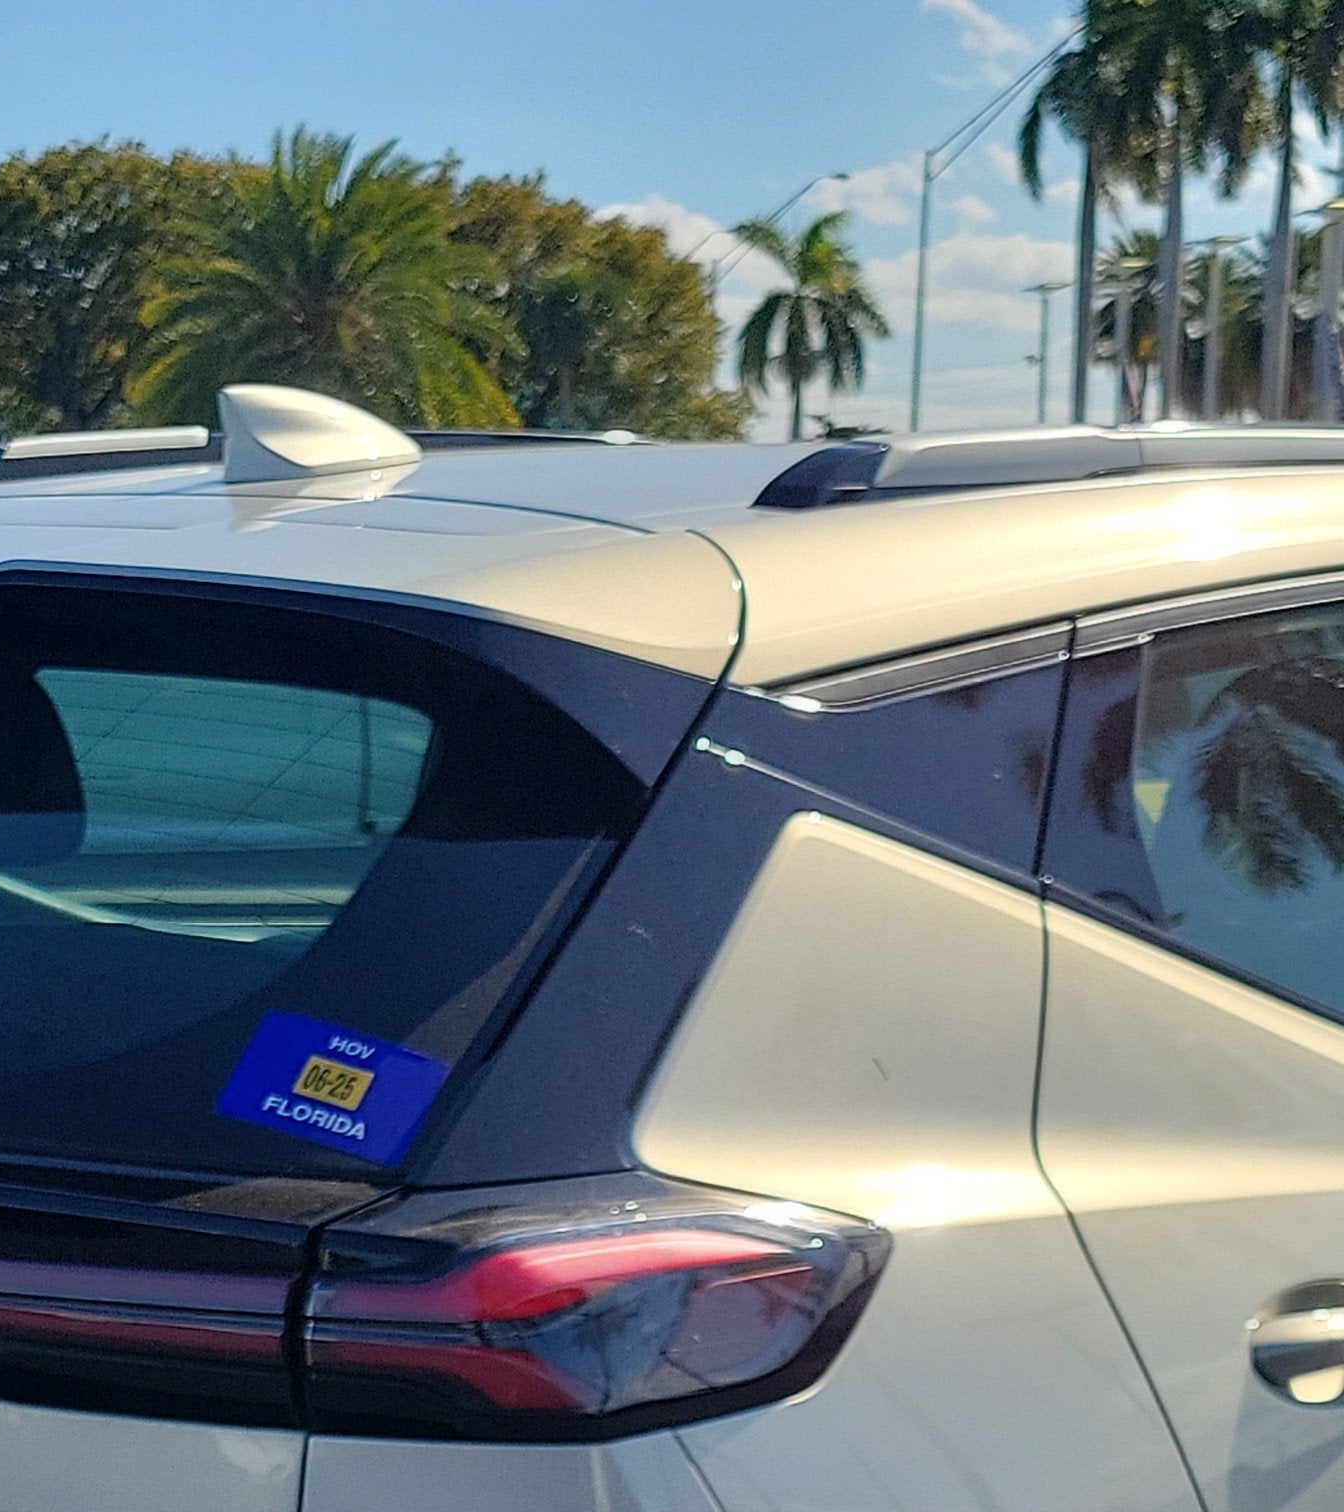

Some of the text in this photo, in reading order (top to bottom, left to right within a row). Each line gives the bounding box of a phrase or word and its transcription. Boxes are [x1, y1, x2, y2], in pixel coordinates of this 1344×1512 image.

[328, 1035, 376, 1060] HOV
[304, 1064, 358, 1102] 06-25
[262, 1095, 366, 1141] FLORIDA
